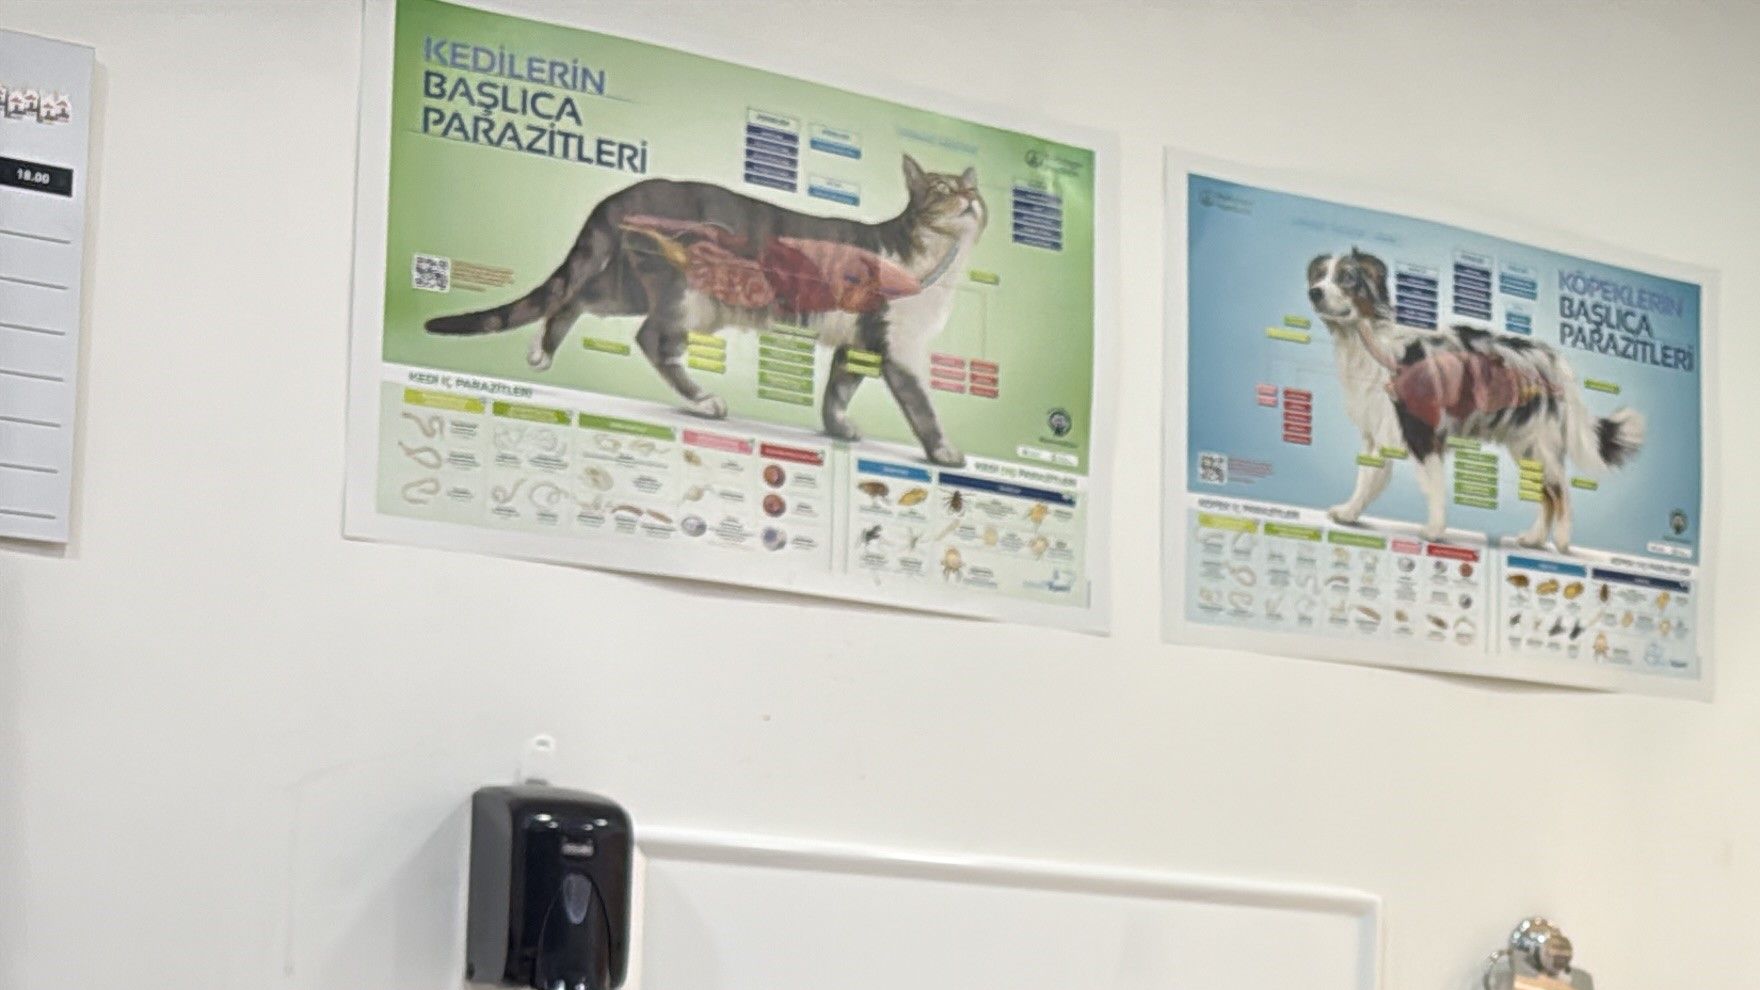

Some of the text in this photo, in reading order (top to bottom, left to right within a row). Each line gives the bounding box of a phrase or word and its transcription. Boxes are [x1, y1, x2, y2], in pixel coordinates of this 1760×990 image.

[423, 34, 606, 95] KEDİLERİN
[423, 70, 583, 127] BAŞLICA
[422, 106, 648, 174] PARAZİTLERİ
[1559, 296, 1654, 337] BAŞLICA
[1559, 322, 1695, 373] PARAZİTLERİ
